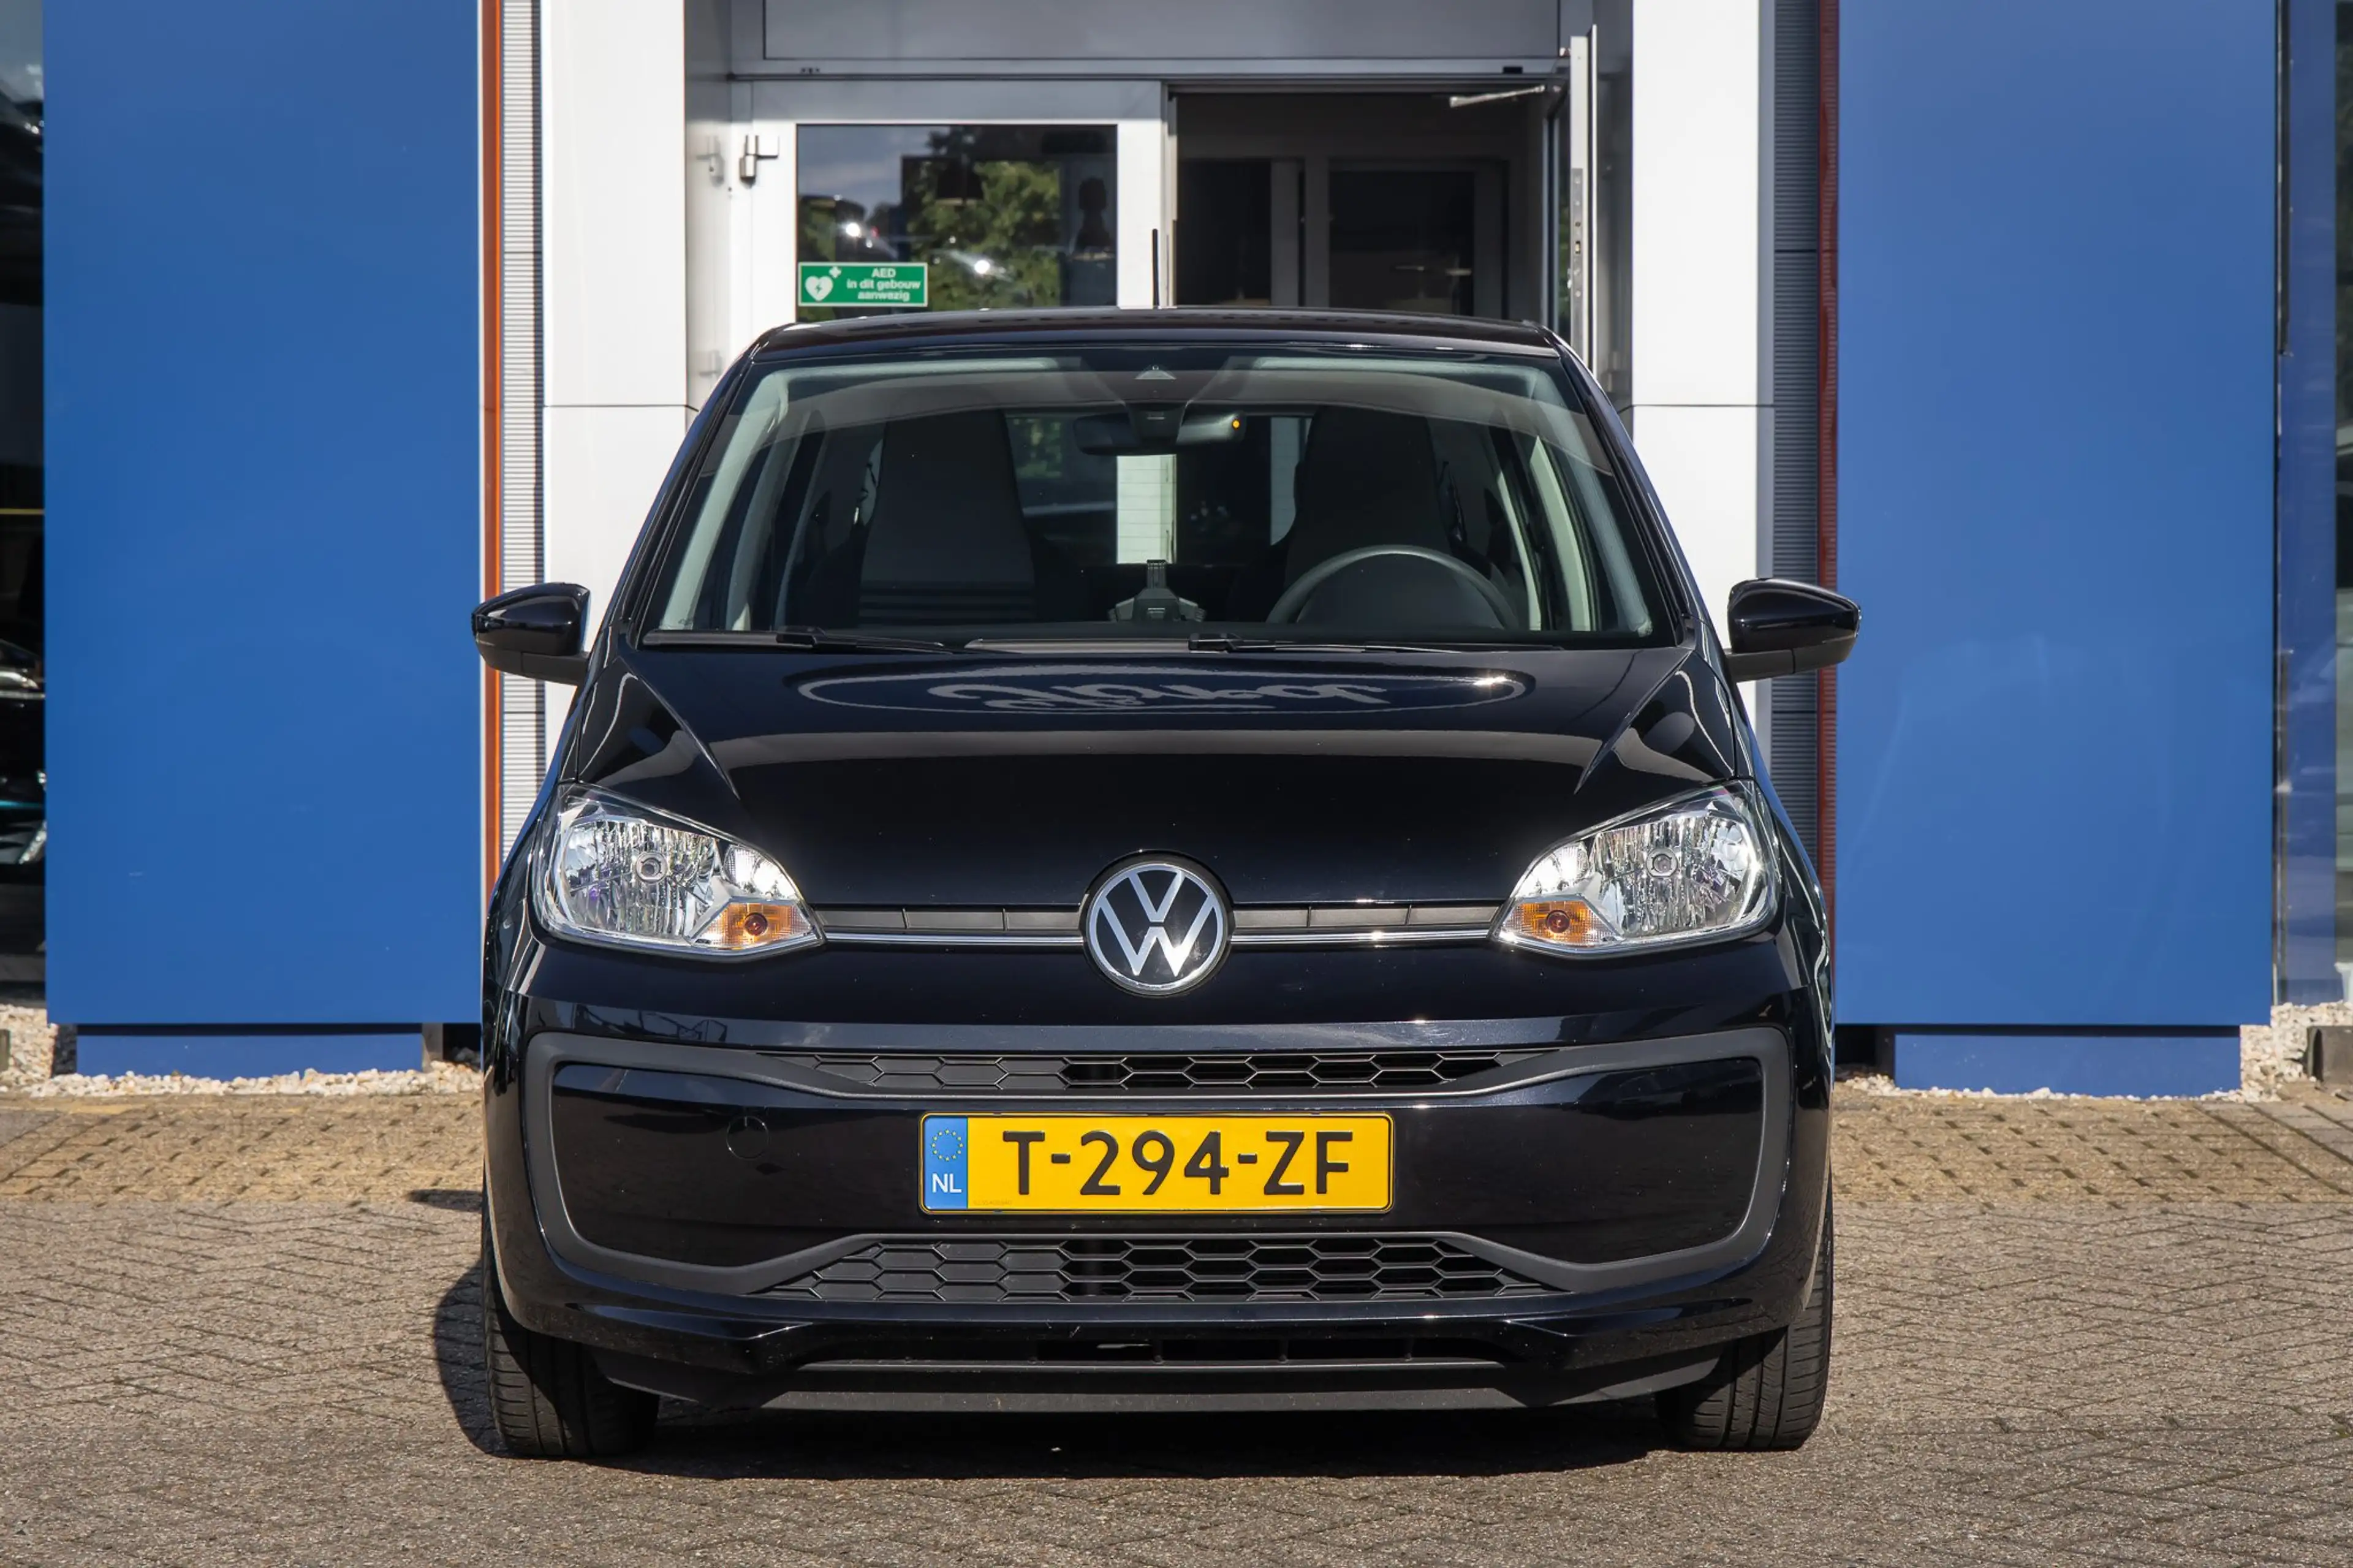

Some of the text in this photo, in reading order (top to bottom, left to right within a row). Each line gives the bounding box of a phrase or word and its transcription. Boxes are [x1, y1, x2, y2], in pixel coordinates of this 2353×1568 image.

[871, 268, 896, 278] AED
[846, 278, 921, 290] in dit gebouw
[857, 290, 910, 301] aanwezig
[1002, 1130, 1353, 1195] T-294-ZF
[932, 1173, 962, 1193] NL
